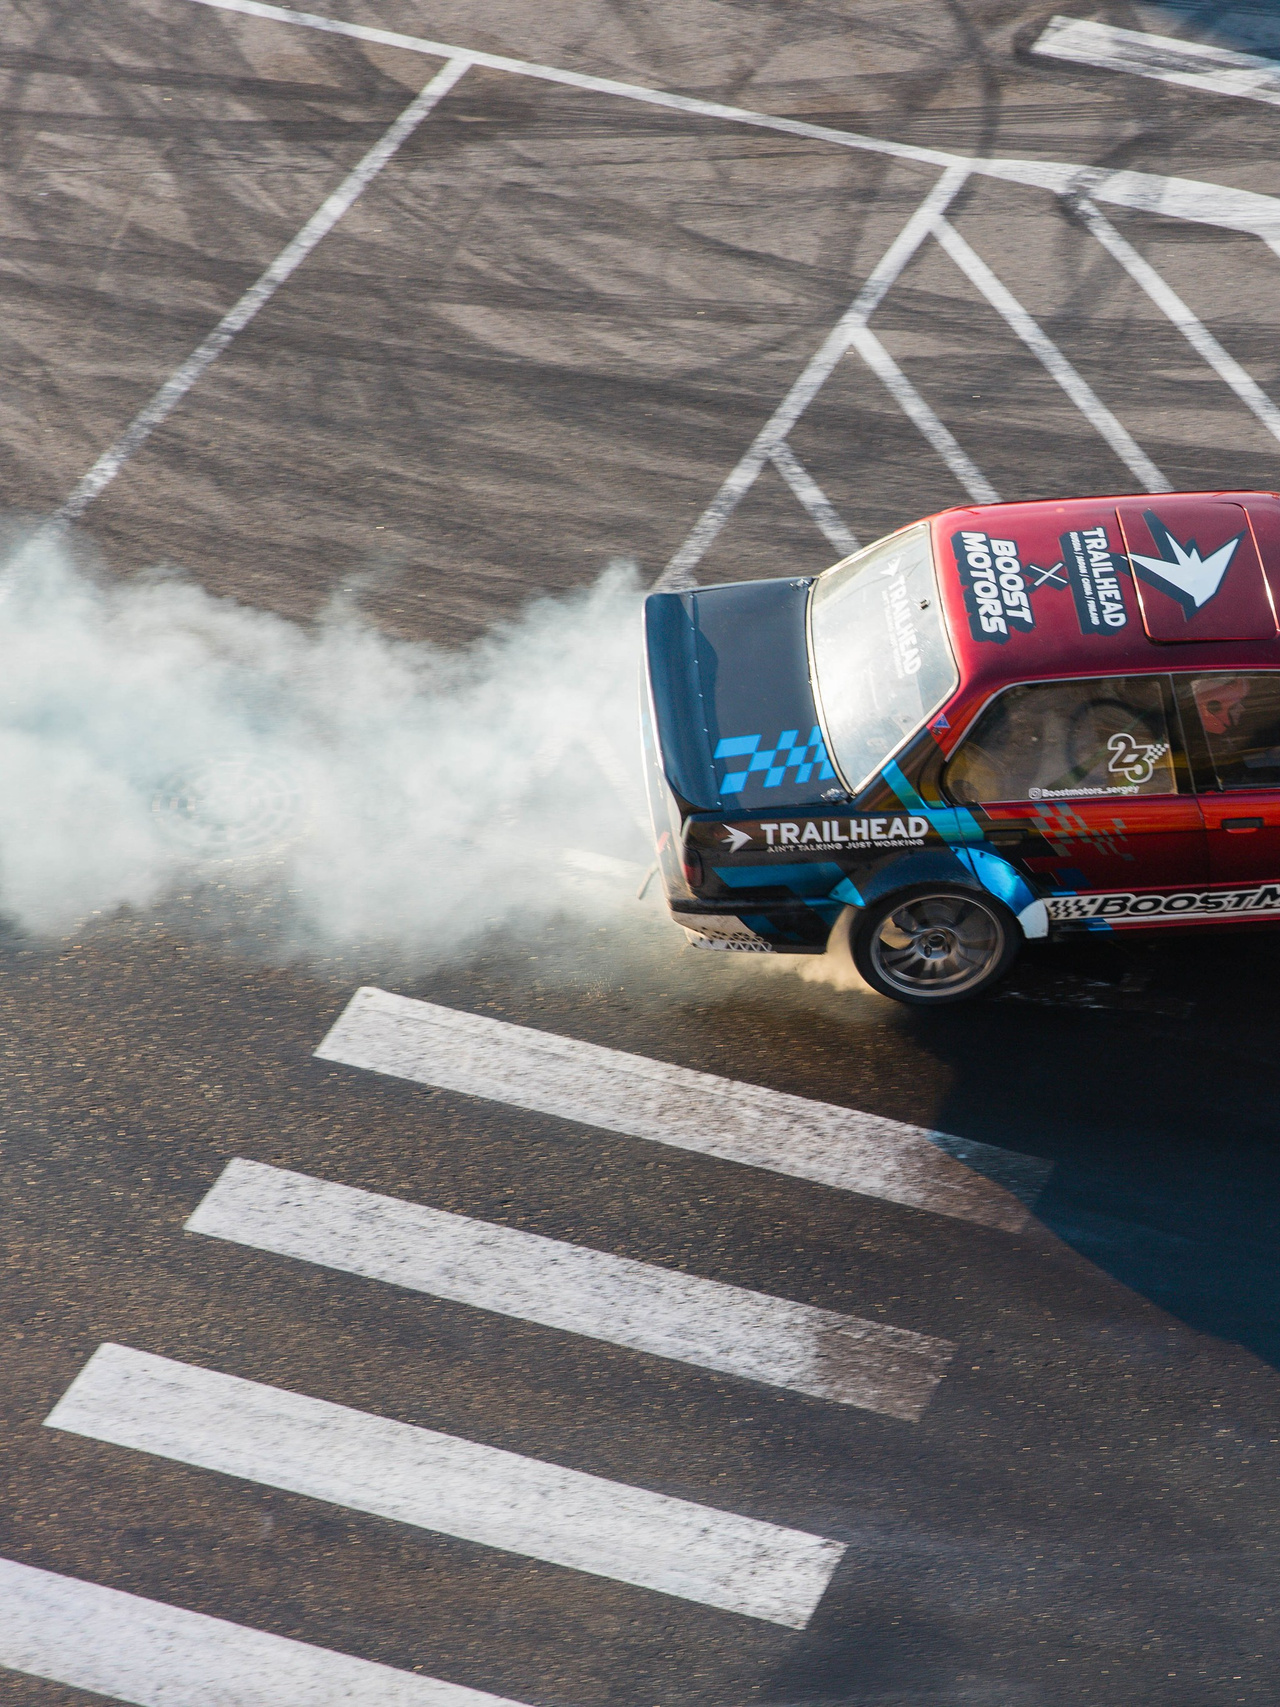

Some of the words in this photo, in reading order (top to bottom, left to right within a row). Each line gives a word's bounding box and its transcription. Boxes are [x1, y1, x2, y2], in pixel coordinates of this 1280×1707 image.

[961, 532, 1008, 635] MOTORS
[990, 539, 1033, 624] BOOST
[1082, 527, 1127, 627] TRAILHEAD
[888, 574, 922, 675] TRAILHEAD
[760, 816, 929, 845] TRAILHEAD
[767, 844, 795, 854] AIN'T
[797, 842, 843, 853] TALKING
[846, 840, 873, 850] JUST
[873, 838, 925, 849] WORKING
